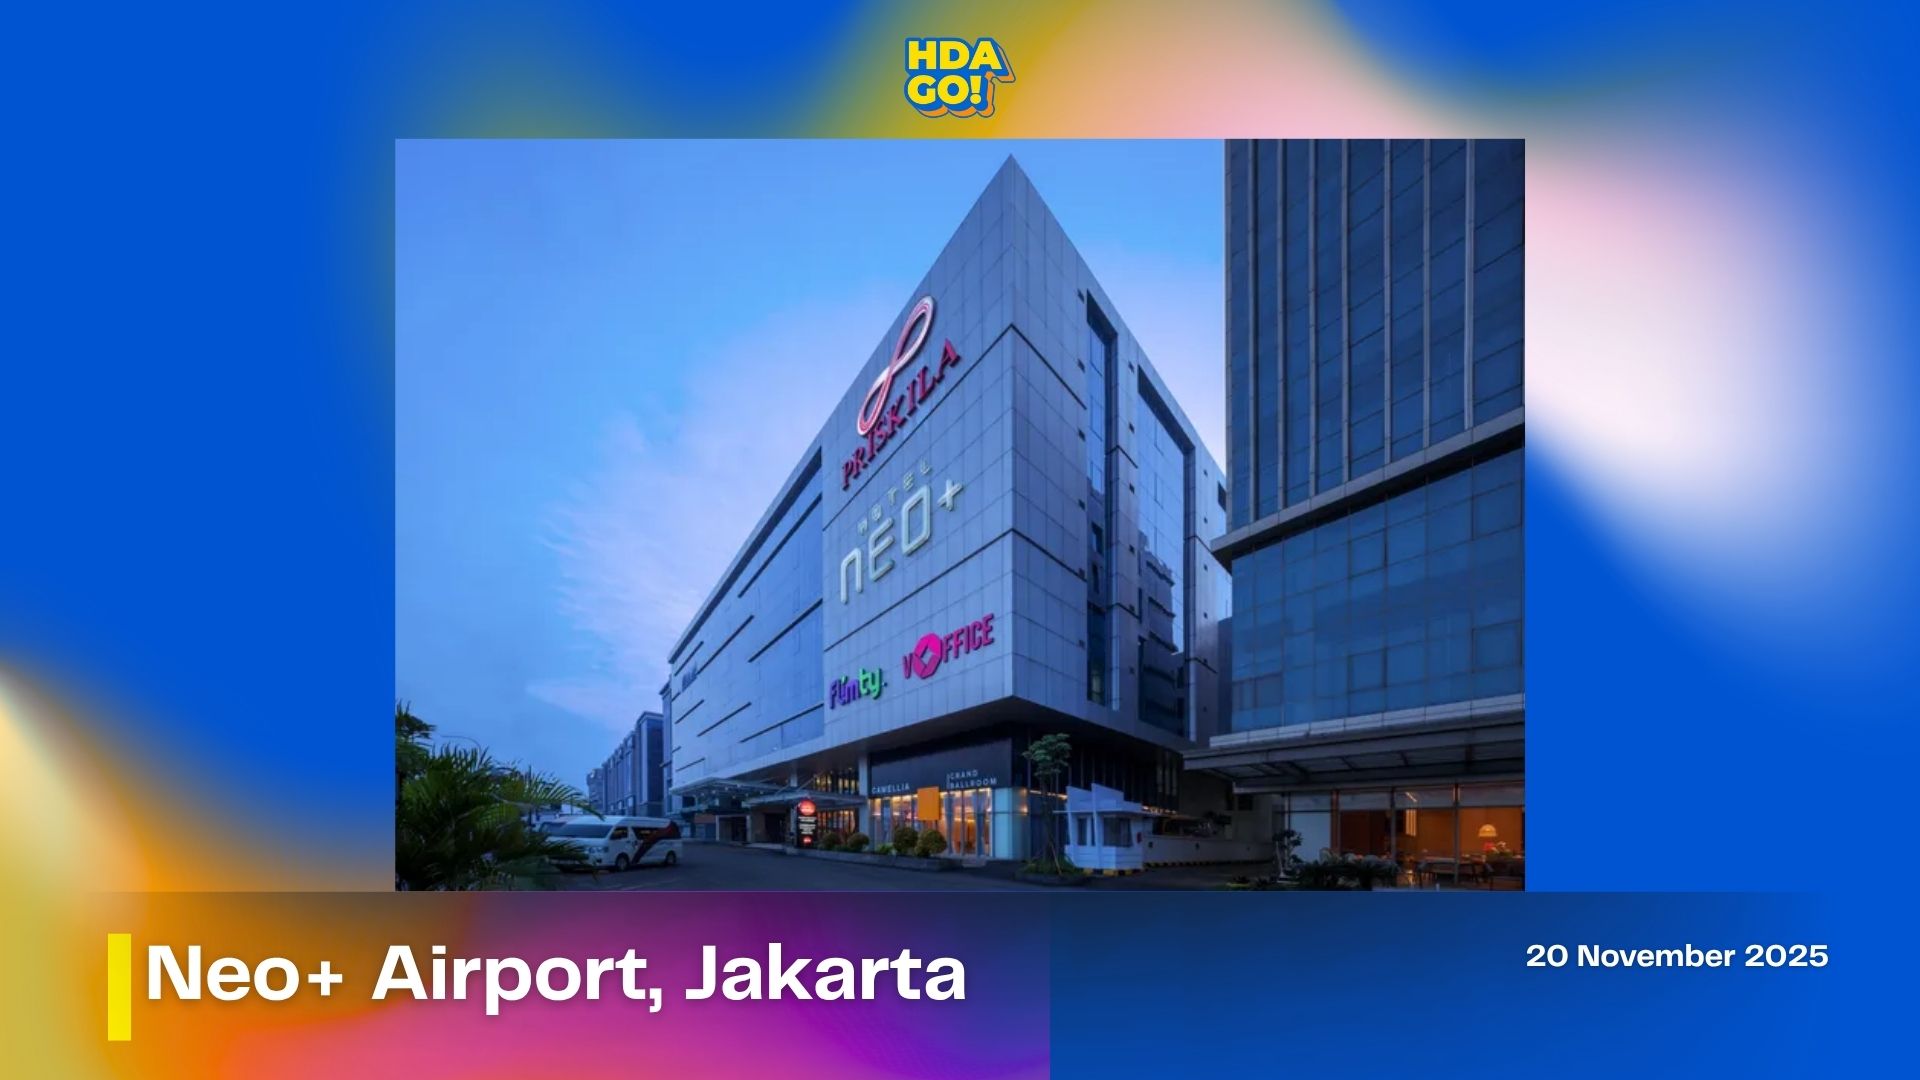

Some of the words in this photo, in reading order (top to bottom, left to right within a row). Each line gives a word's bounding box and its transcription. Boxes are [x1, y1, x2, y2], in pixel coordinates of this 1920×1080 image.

[842, 337, 961, 490] PRISKILA
[857, 456, 932, 536] HOTEL
[950, 778, 997, 790] BALLROOM
